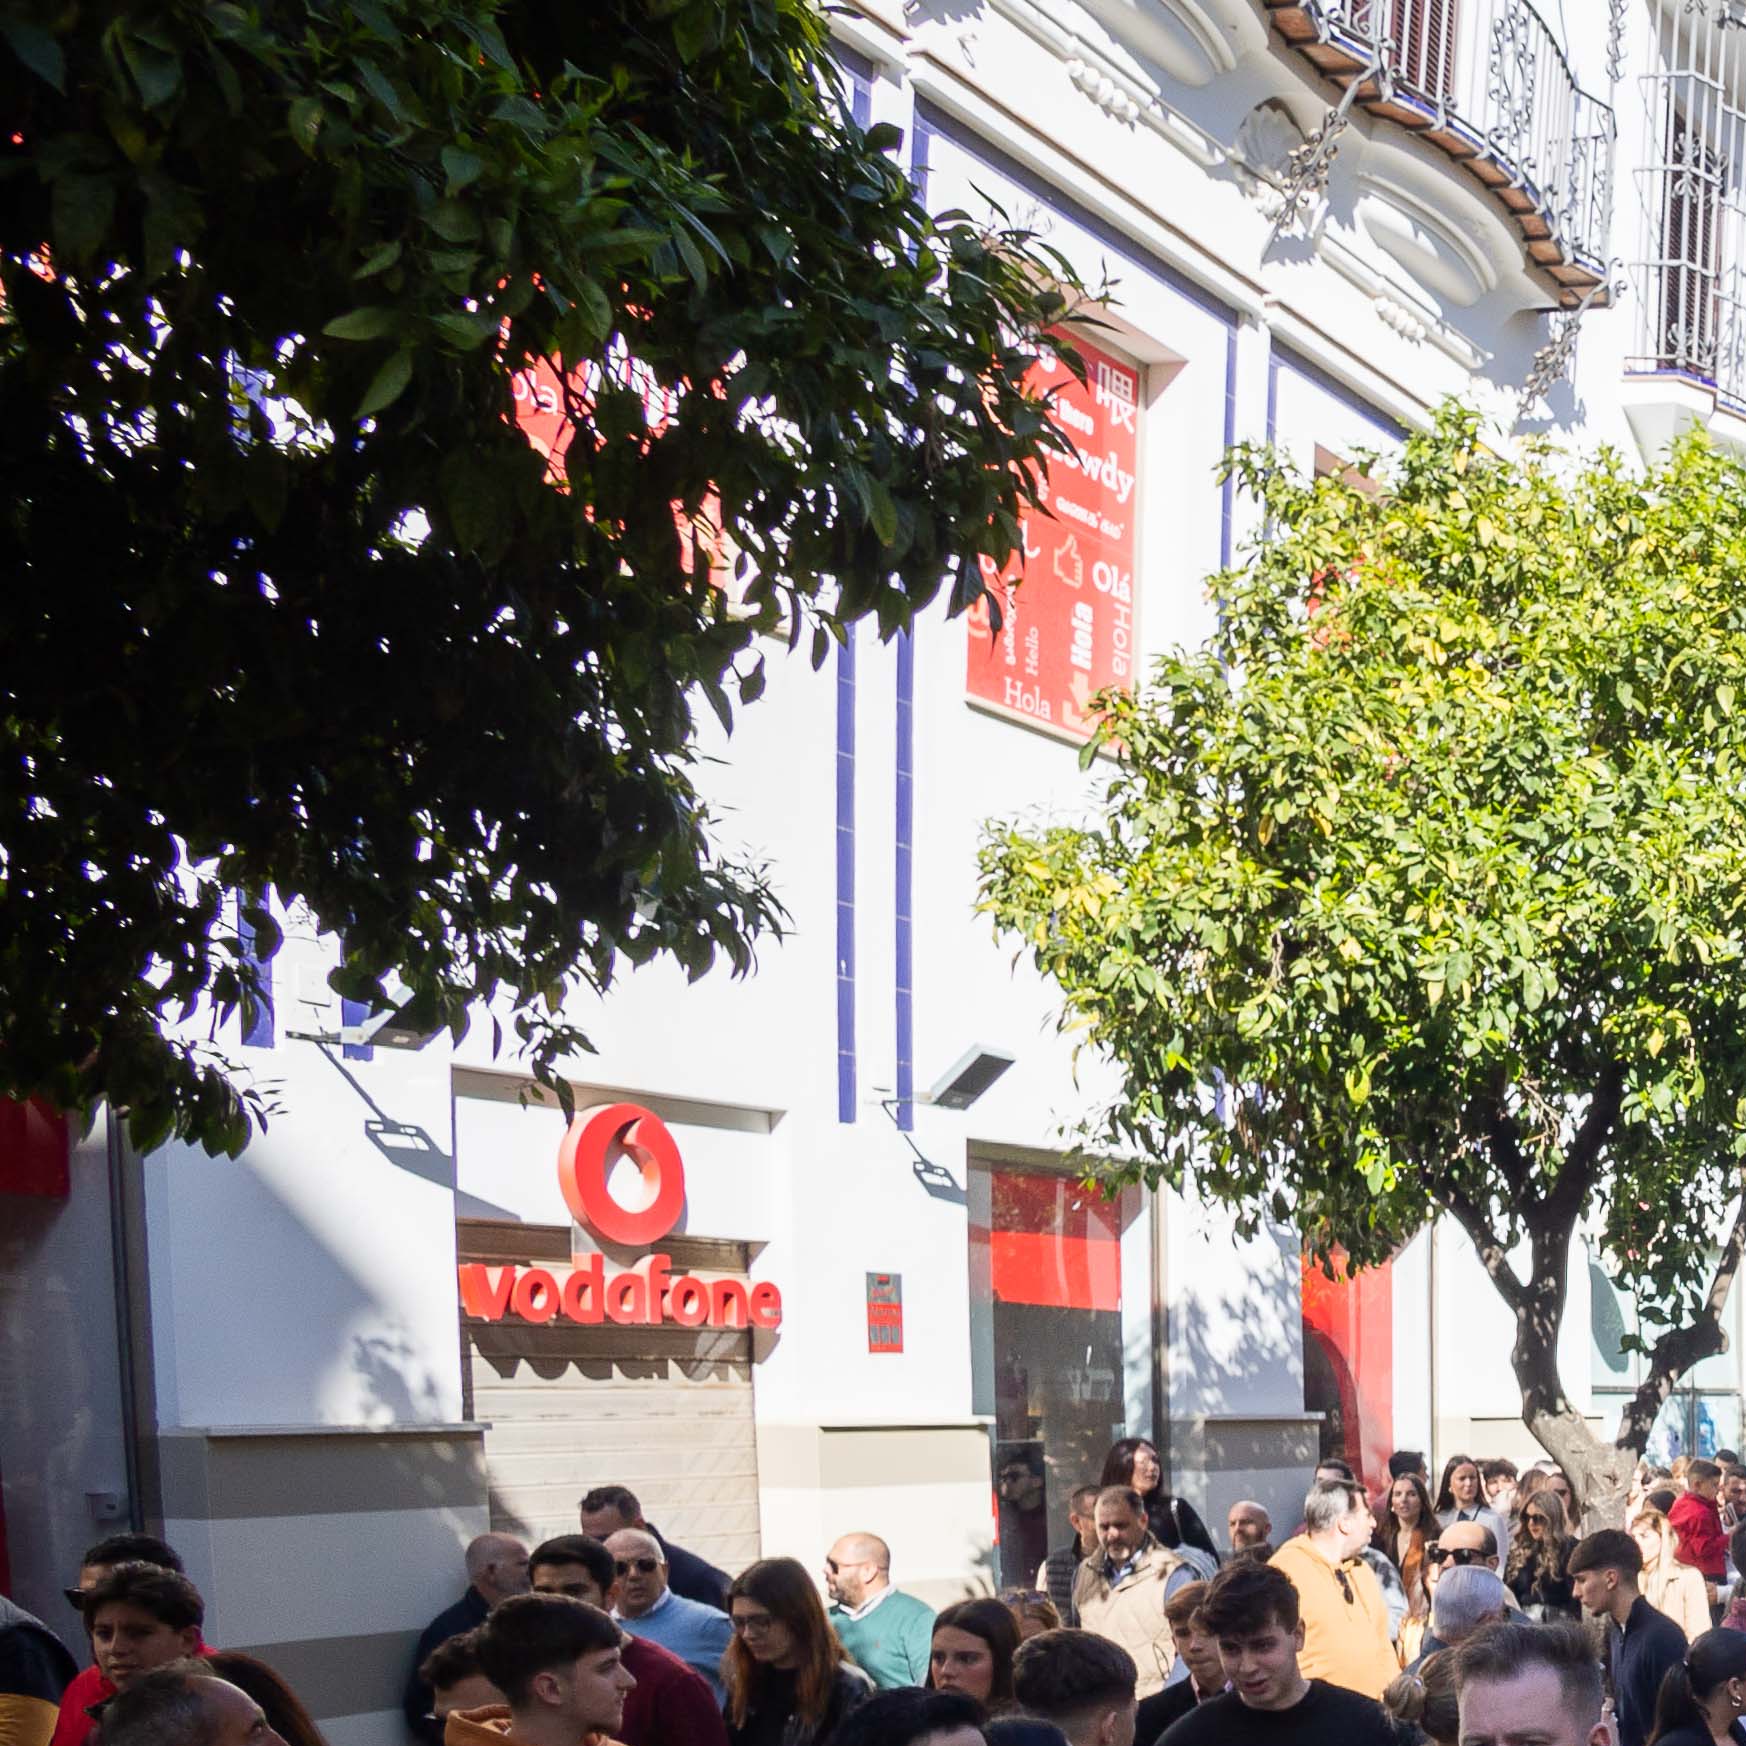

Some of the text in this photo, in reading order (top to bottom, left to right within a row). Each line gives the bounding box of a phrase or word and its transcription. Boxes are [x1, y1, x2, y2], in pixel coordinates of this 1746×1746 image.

[1092, 560, 1131, 602] Olá
[1025, 626, 1039, 677] Hello
[1070, 601, 1094, 671] Hola
[1111, 602, 1132, 676] Hola
[1004, 675, 1051, 721] Hola
[457, 1253, 782, 1329] vodafone
